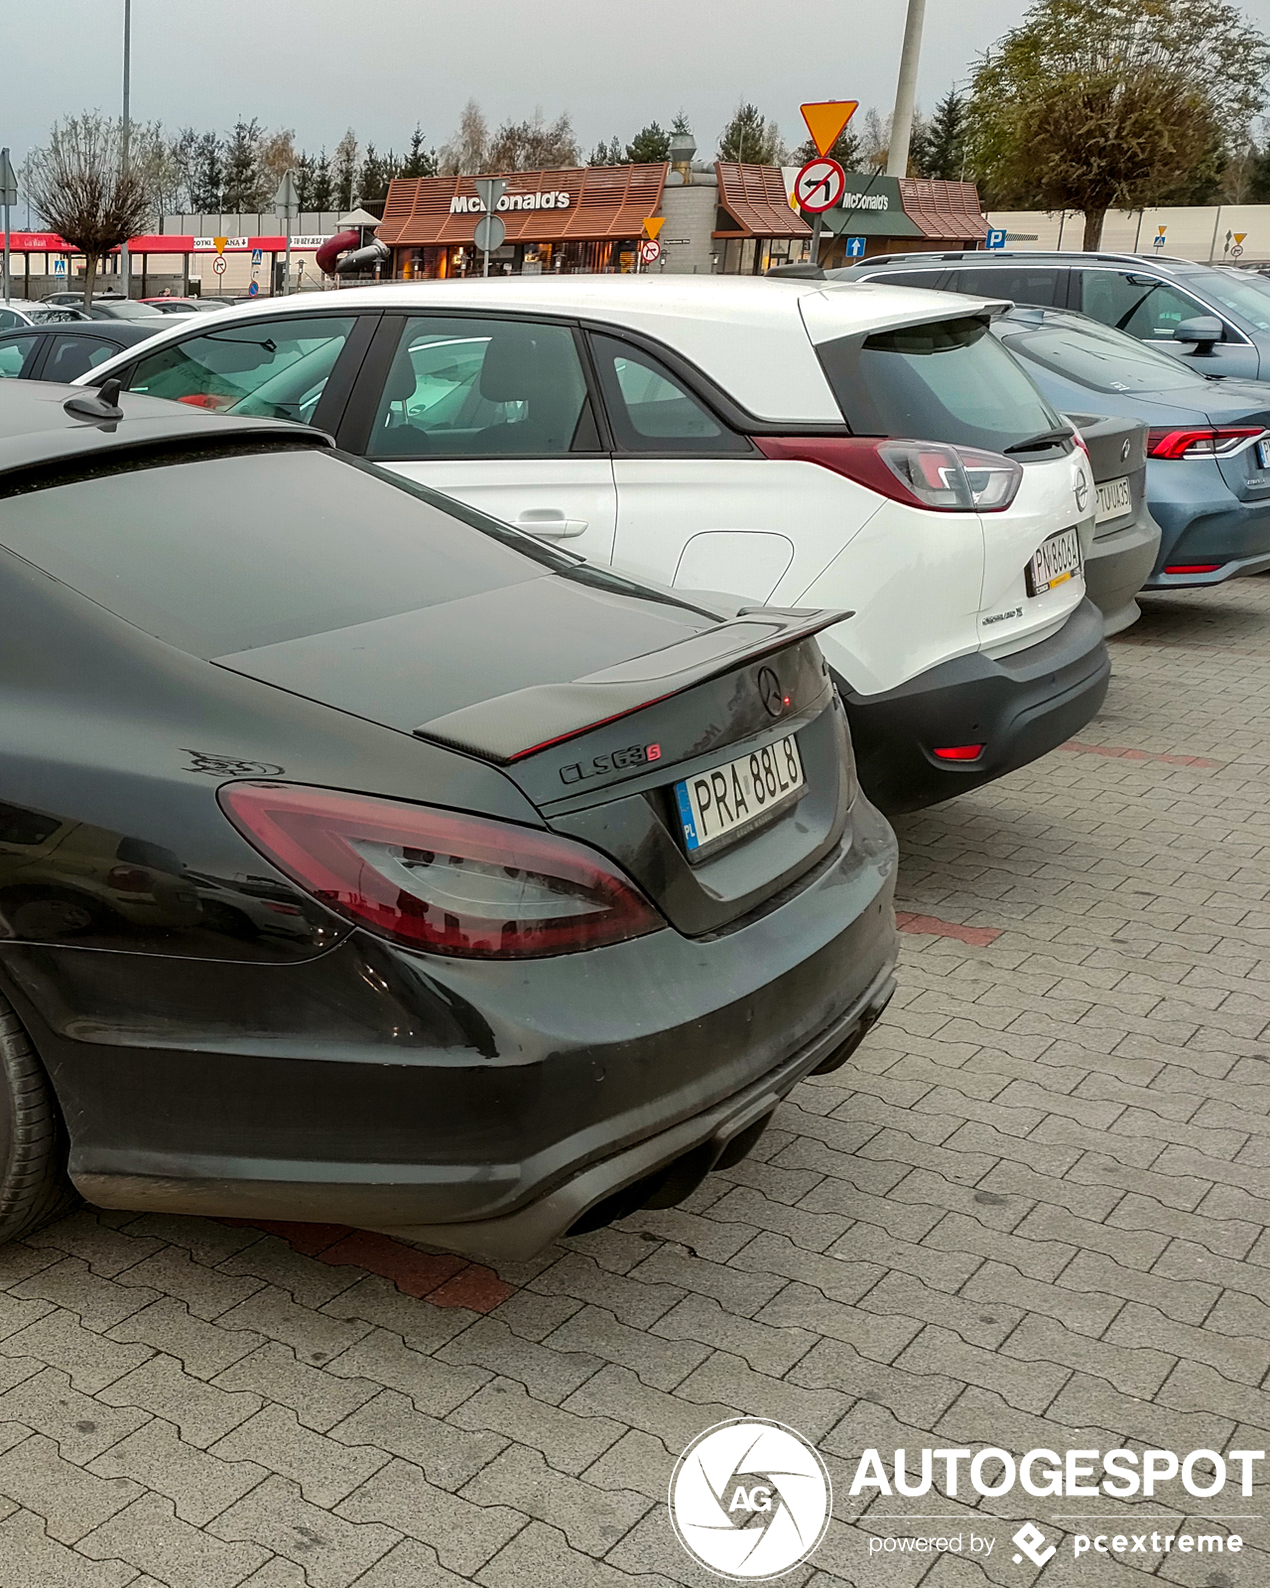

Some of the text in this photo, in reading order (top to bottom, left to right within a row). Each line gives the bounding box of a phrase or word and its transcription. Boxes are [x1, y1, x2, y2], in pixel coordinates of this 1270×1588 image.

[450, 191, 570, 213] Mconald's
[842, 192, 889, 211] McDonald's
[990, 231, 1003, 247] P
[694, 763, 749, 836] PRA
[750, 736, 798, 805] 88L8
[684, 823, 696, 840] PL
